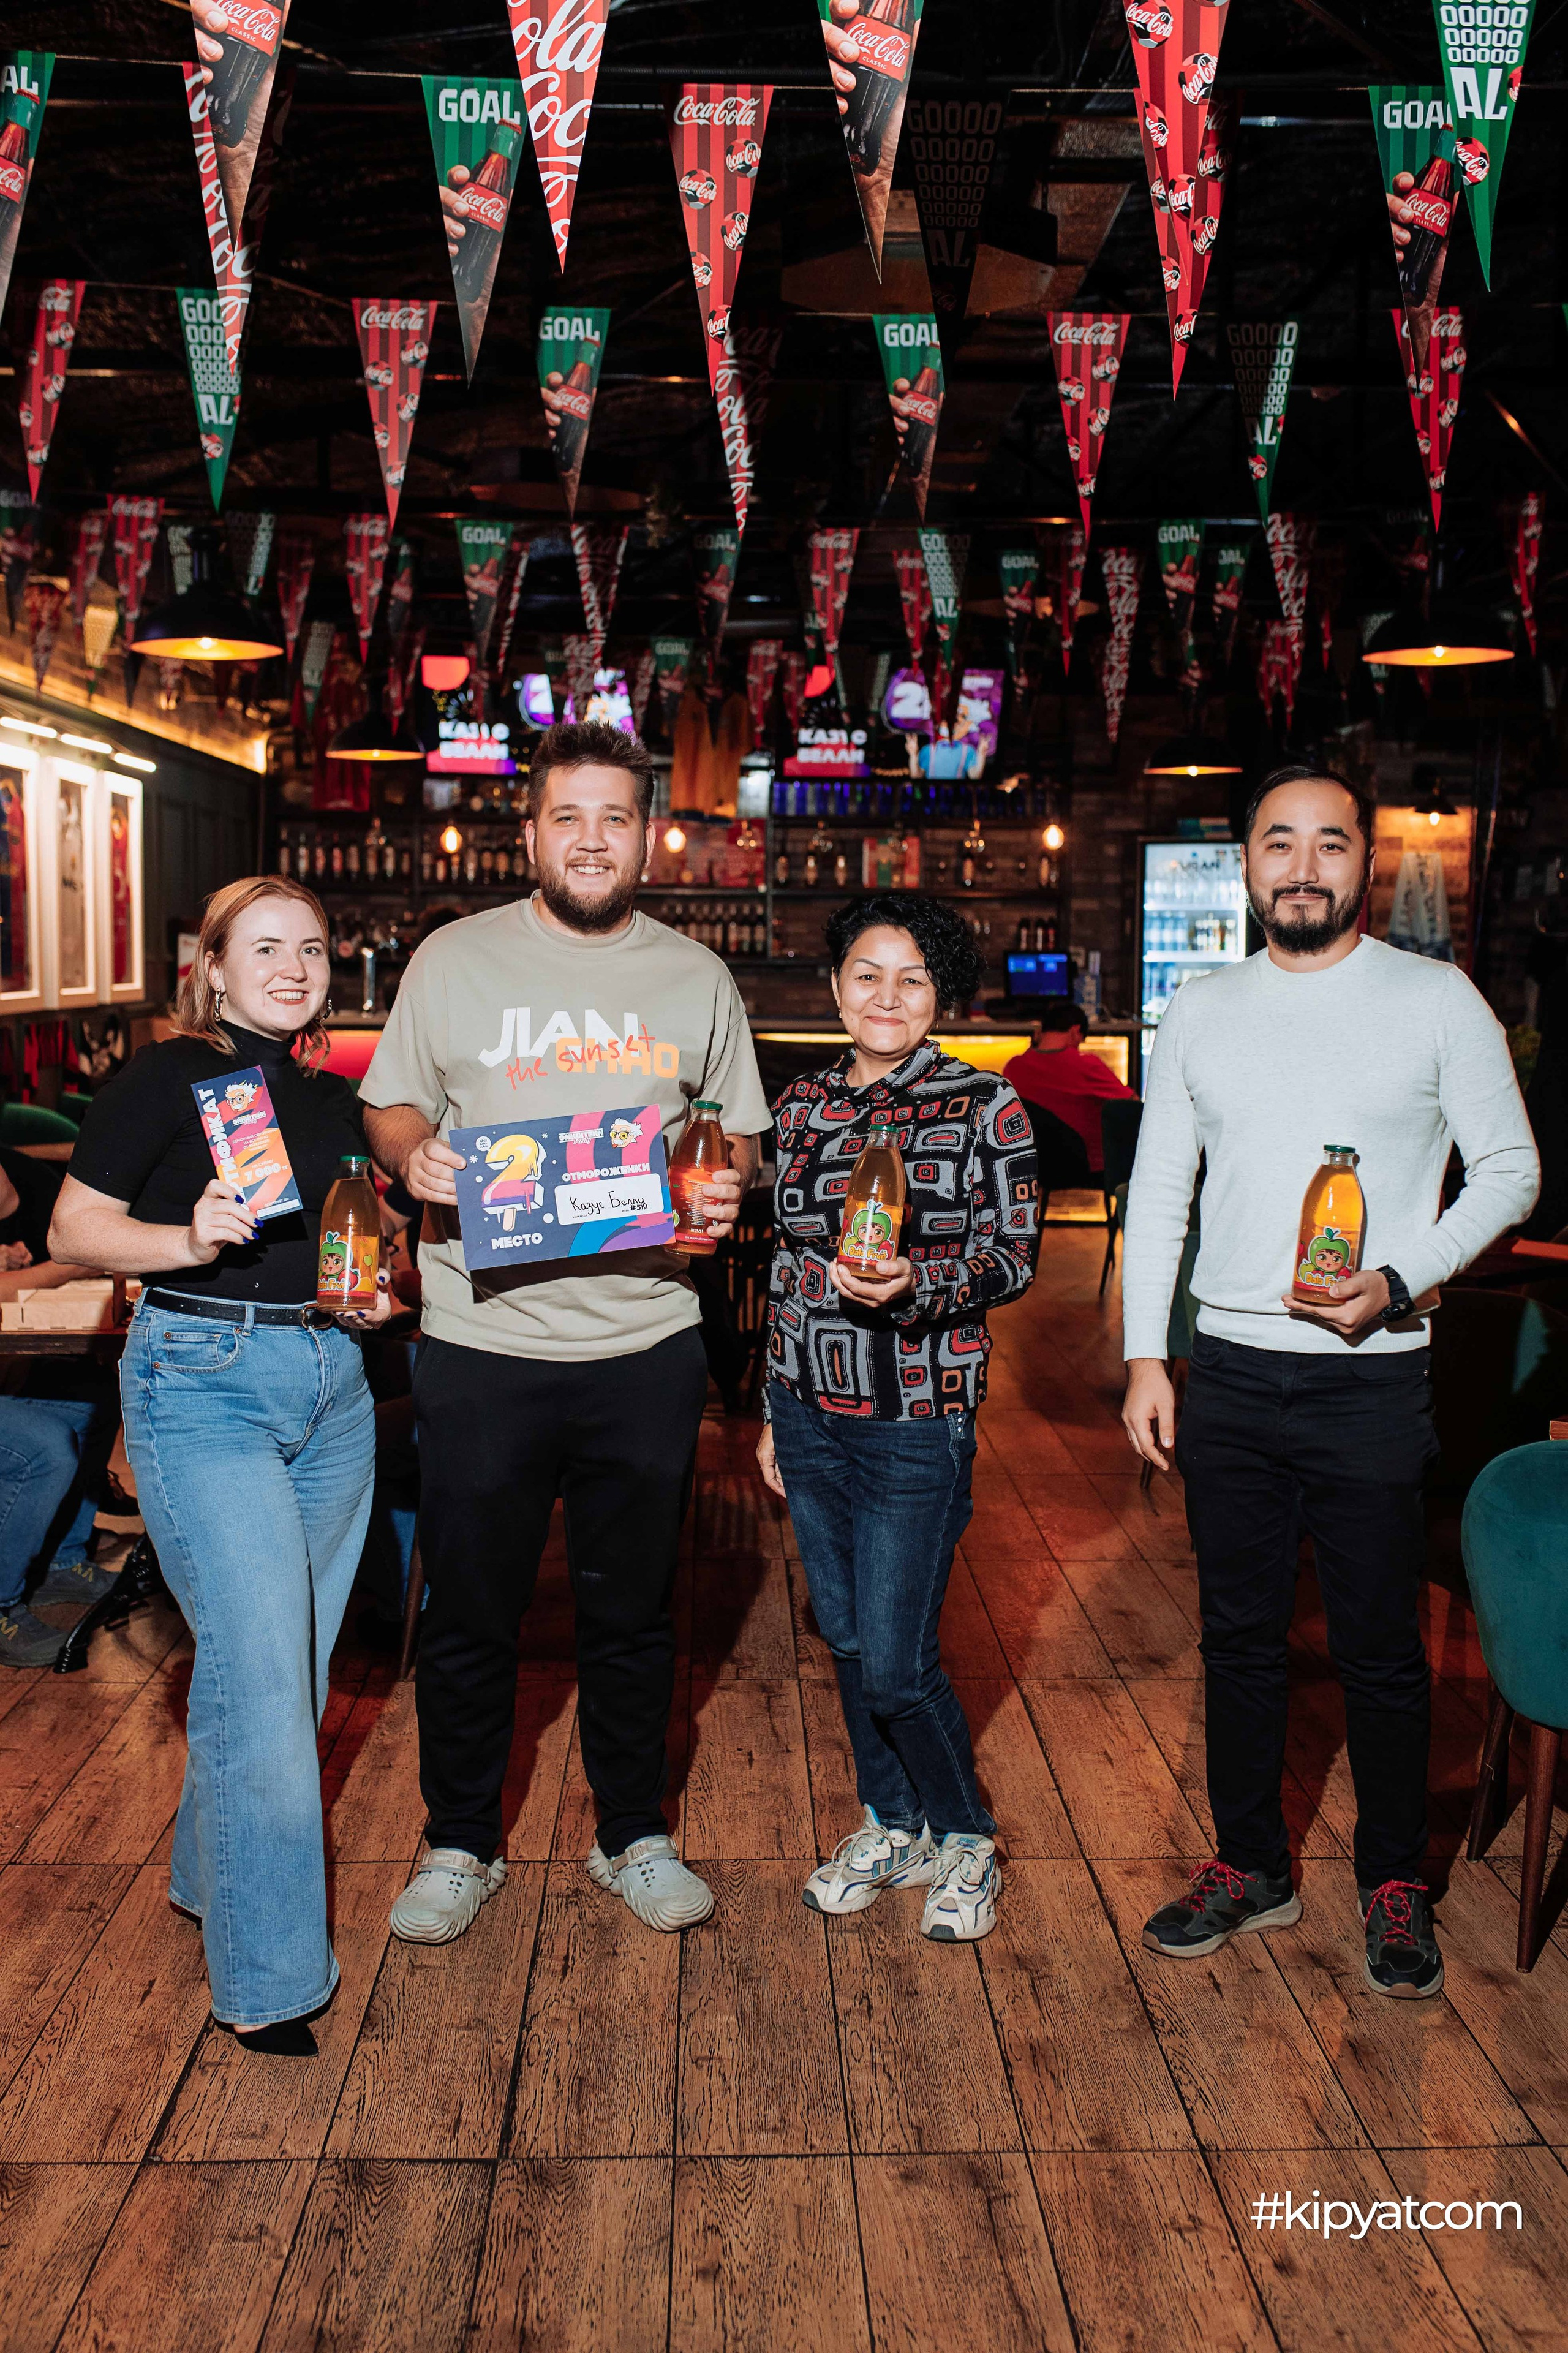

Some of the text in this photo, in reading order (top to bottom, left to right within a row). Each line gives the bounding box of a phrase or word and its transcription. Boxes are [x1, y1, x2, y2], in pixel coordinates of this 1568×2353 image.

[231, 26, 257, 42] CLASSIC
[847, 22, 910, 67] Coca-Cola
[862, 56, 888, 70] CLASSIC
[439, 88, 521, 124] GOAL
[1450, 67, 1508, 121] AL
[674, 95, 760, 126] Coca-Cola
[460, 187, 505, 222] Coca-Cola
[1404, 192, 1451, 228] Coca-Cola
[1415, 217, 1433, 228] CLASSIC
[181, 298, 222, 323] GOO
[361, 306, 428, 330] Coca-Cola
[539, 316, 600, 341] GOAL
[1054, 321, 1120, 345] Coca-Cola
[197, 394, 233, 425] AL
[1244, 415, 1277, 445] AL
[462, 526, 507, 545] GOAL
[1158, 524, 1200, 543] GOAL
[478, 1007, 640, 1068] JIAN
[505, 1024, 656, 1091] the sunset
[556, 1037, 680, 1079] CHAO
[244, 1171, 252, 1182] 7
[255, 1162, 281, 1178] 000
[481, 1134, 546, 1214] 2
[562, 1163, 650, 1182] ОТМОРОЖЕНКИ
[569, 1196, 605, 1215] Казус
[491, 1232, 543, 1250] МЕСТО
[849, 1246, 888, 1260] Dala Fruit
[329, 1279, 345, 1290] Frui
[1305, 1274, 1323, 1286] Dala
